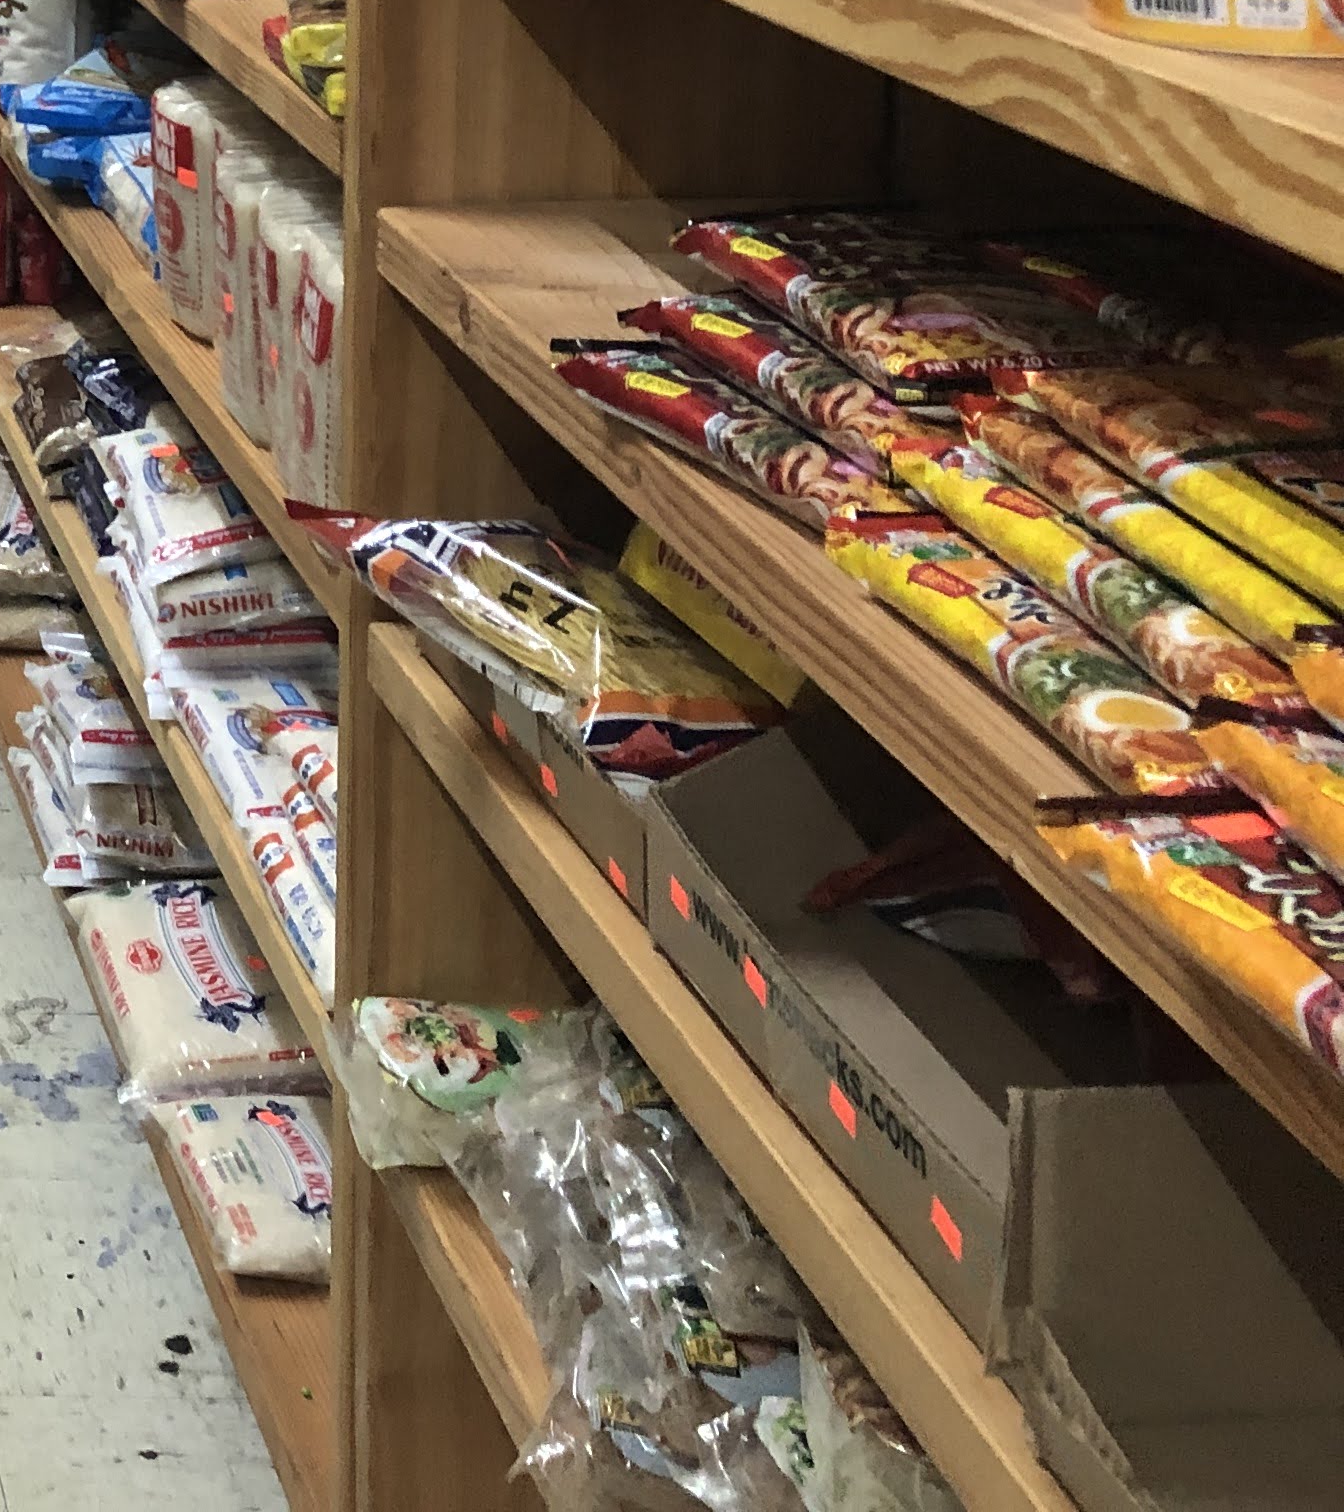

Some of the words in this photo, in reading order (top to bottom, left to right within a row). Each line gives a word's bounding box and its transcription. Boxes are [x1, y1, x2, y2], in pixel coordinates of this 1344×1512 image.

[181, 591, 275, 619] NISHIKI
[95, 833, 175, 859] NISHIKI
[168, 897, 201, 930] RICE
[177, 933, 249, 1006] JASMINE
